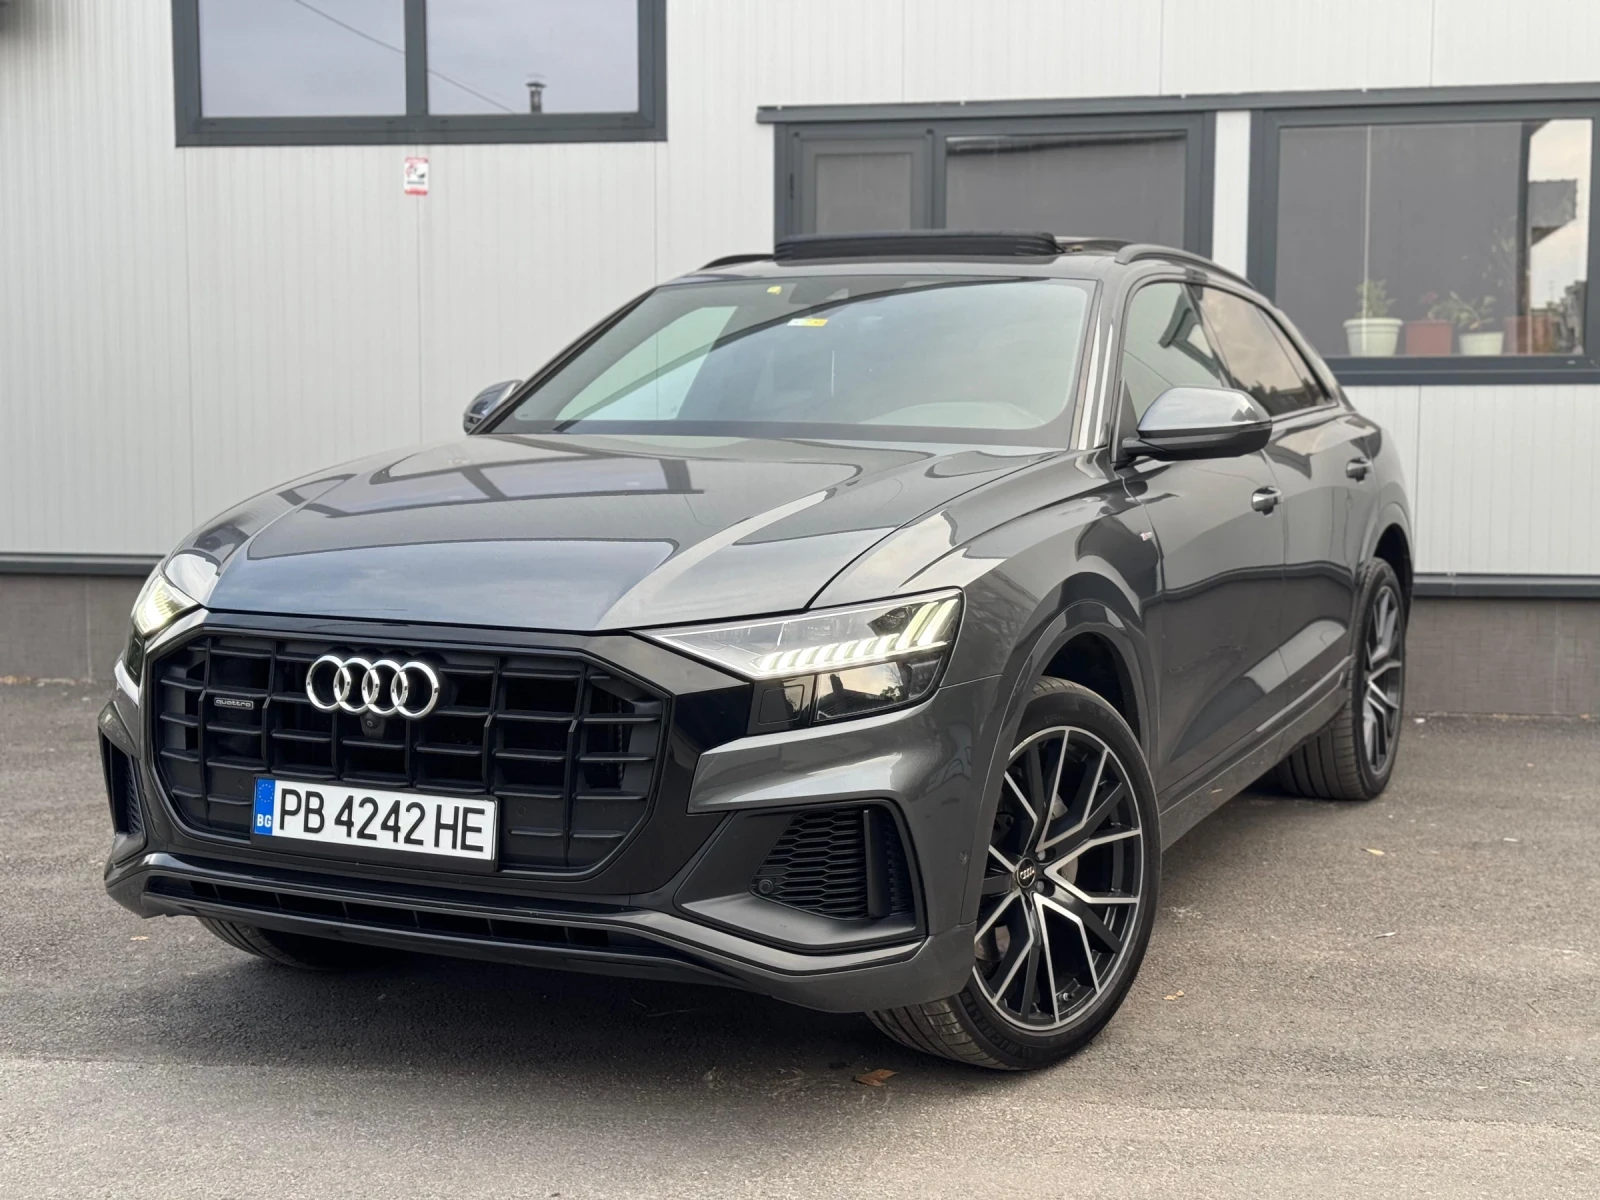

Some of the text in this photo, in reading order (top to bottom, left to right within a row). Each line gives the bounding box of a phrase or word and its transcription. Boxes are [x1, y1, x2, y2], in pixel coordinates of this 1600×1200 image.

[215, 699, 252, 708] quattro
[256, 813, 272, 828] BG
[279, 787, 486, 853] PB 4242 HE
